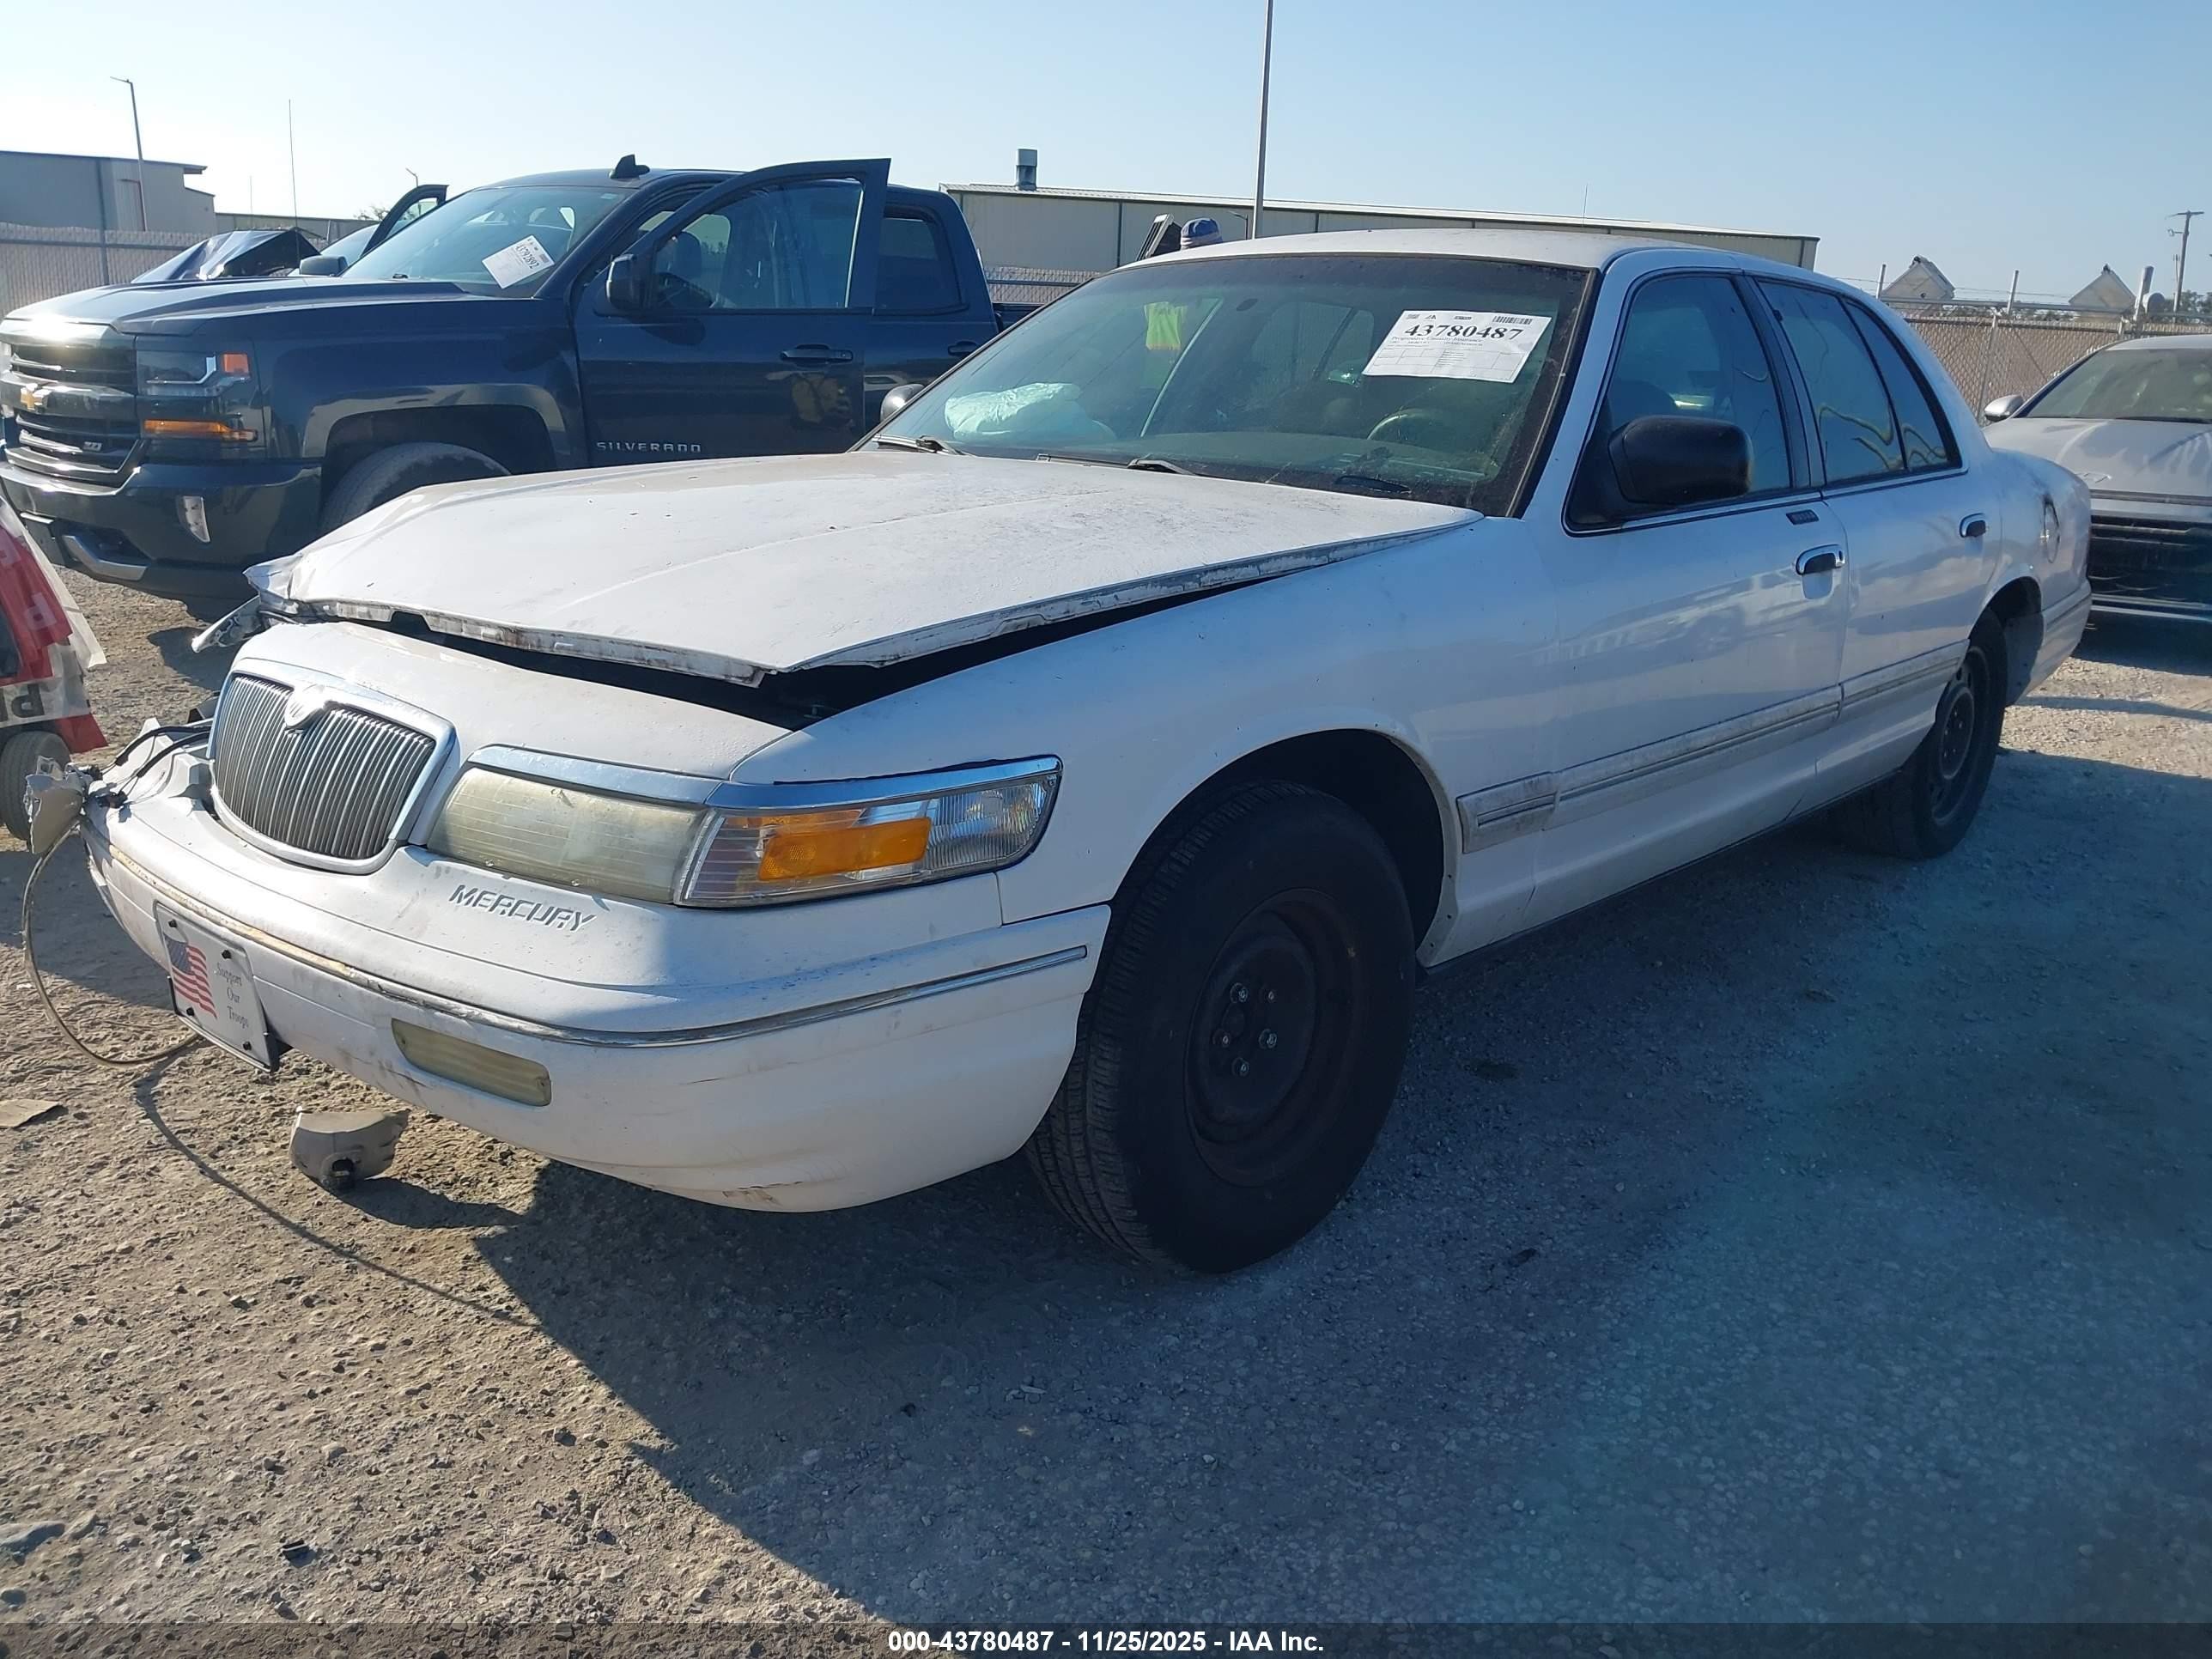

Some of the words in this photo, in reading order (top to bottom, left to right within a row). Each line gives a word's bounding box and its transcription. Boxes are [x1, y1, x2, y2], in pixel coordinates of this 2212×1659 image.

[1405, 324, 1524, 340] 43780487
[597, 441, 702, 453] SILVERADO
[449, 884, 597, 931] MERCURY
[216, 963, 243, 987] Support
[227, 988, 240, 1003] Our
[227, 1006, 249, 1029] Troops
